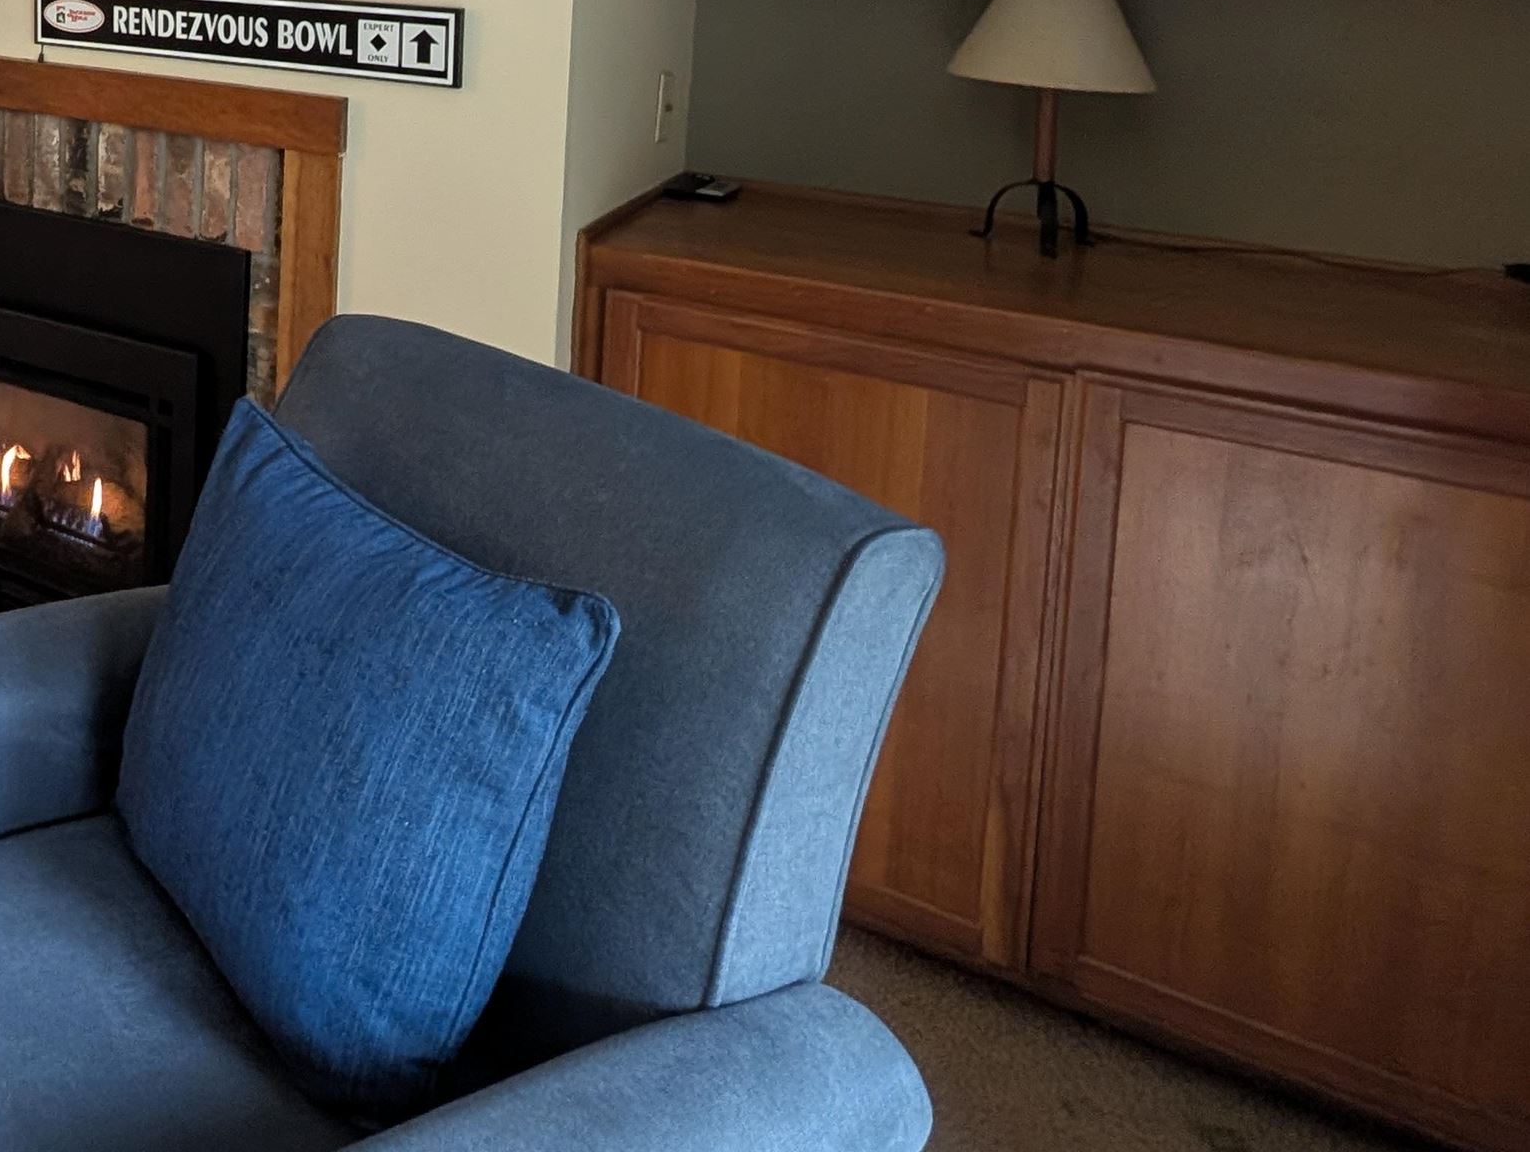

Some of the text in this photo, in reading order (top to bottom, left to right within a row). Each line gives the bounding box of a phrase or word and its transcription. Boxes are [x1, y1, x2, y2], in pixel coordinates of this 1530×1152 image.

[113, 5, 353, 56] RENDEZVOUS BOWL
[363, 22, 395, 32] EXPERT
[367, 54, 389, 63] ONLY
